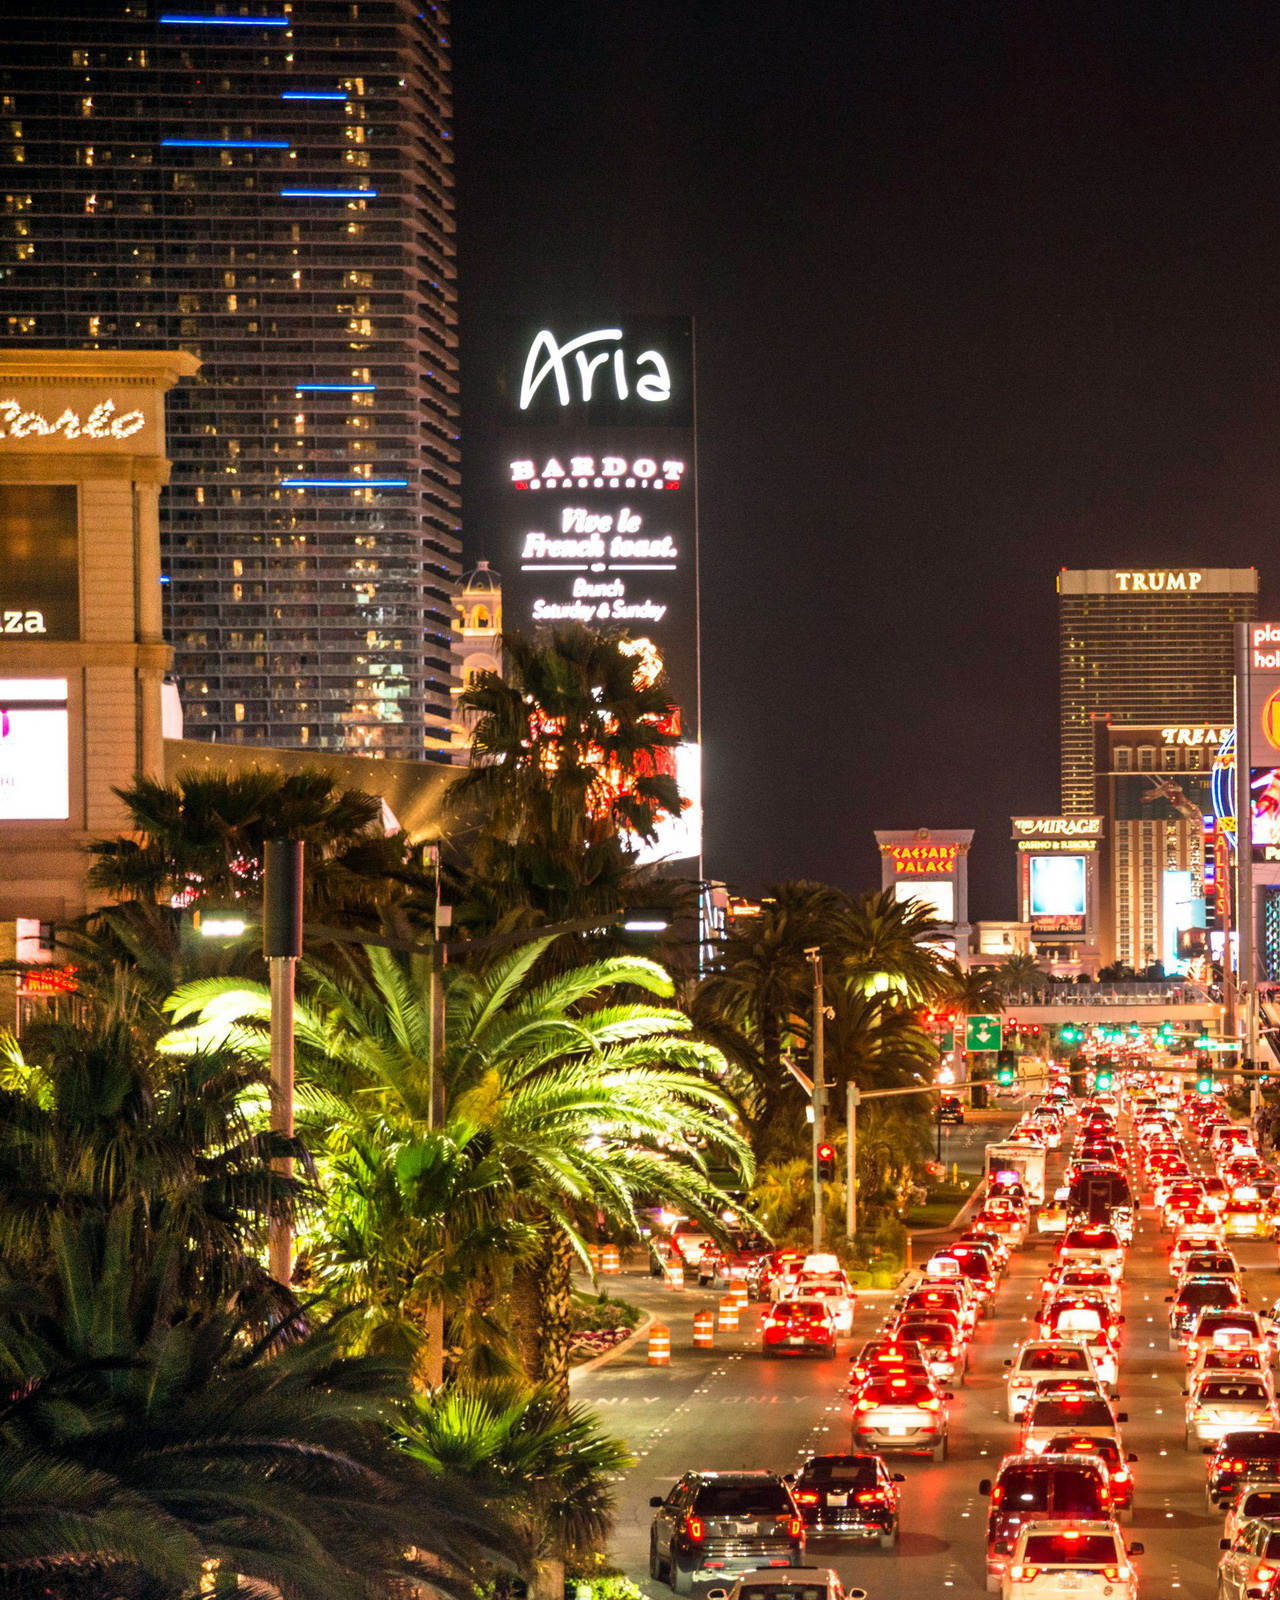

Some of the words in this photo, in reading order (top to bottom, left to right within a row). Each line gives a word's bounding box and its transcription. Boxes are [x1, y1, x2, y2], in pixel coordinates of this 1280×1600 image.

[520, 328, 671, 410] Aria
[510, 457, 685, 481] BARDOT
[617, 507, 642, 533] le
[521, 532, 605, 558] French
[572, 577, 625, 598] Brunch
[1115, 572, 1202, 591] TRUMP
[532, 599, 597, 622] Saturday
[612, 599, 667, 622] Sunday
[1027, 820, 1100, 835] MIRAGE
[892, 847, 957, 859] CAESARS
[1018, 841, 1052, 850] CASINO
[1061, 840, 1097, 849] RESORT
[895, 861, 954, 873] PALACE
